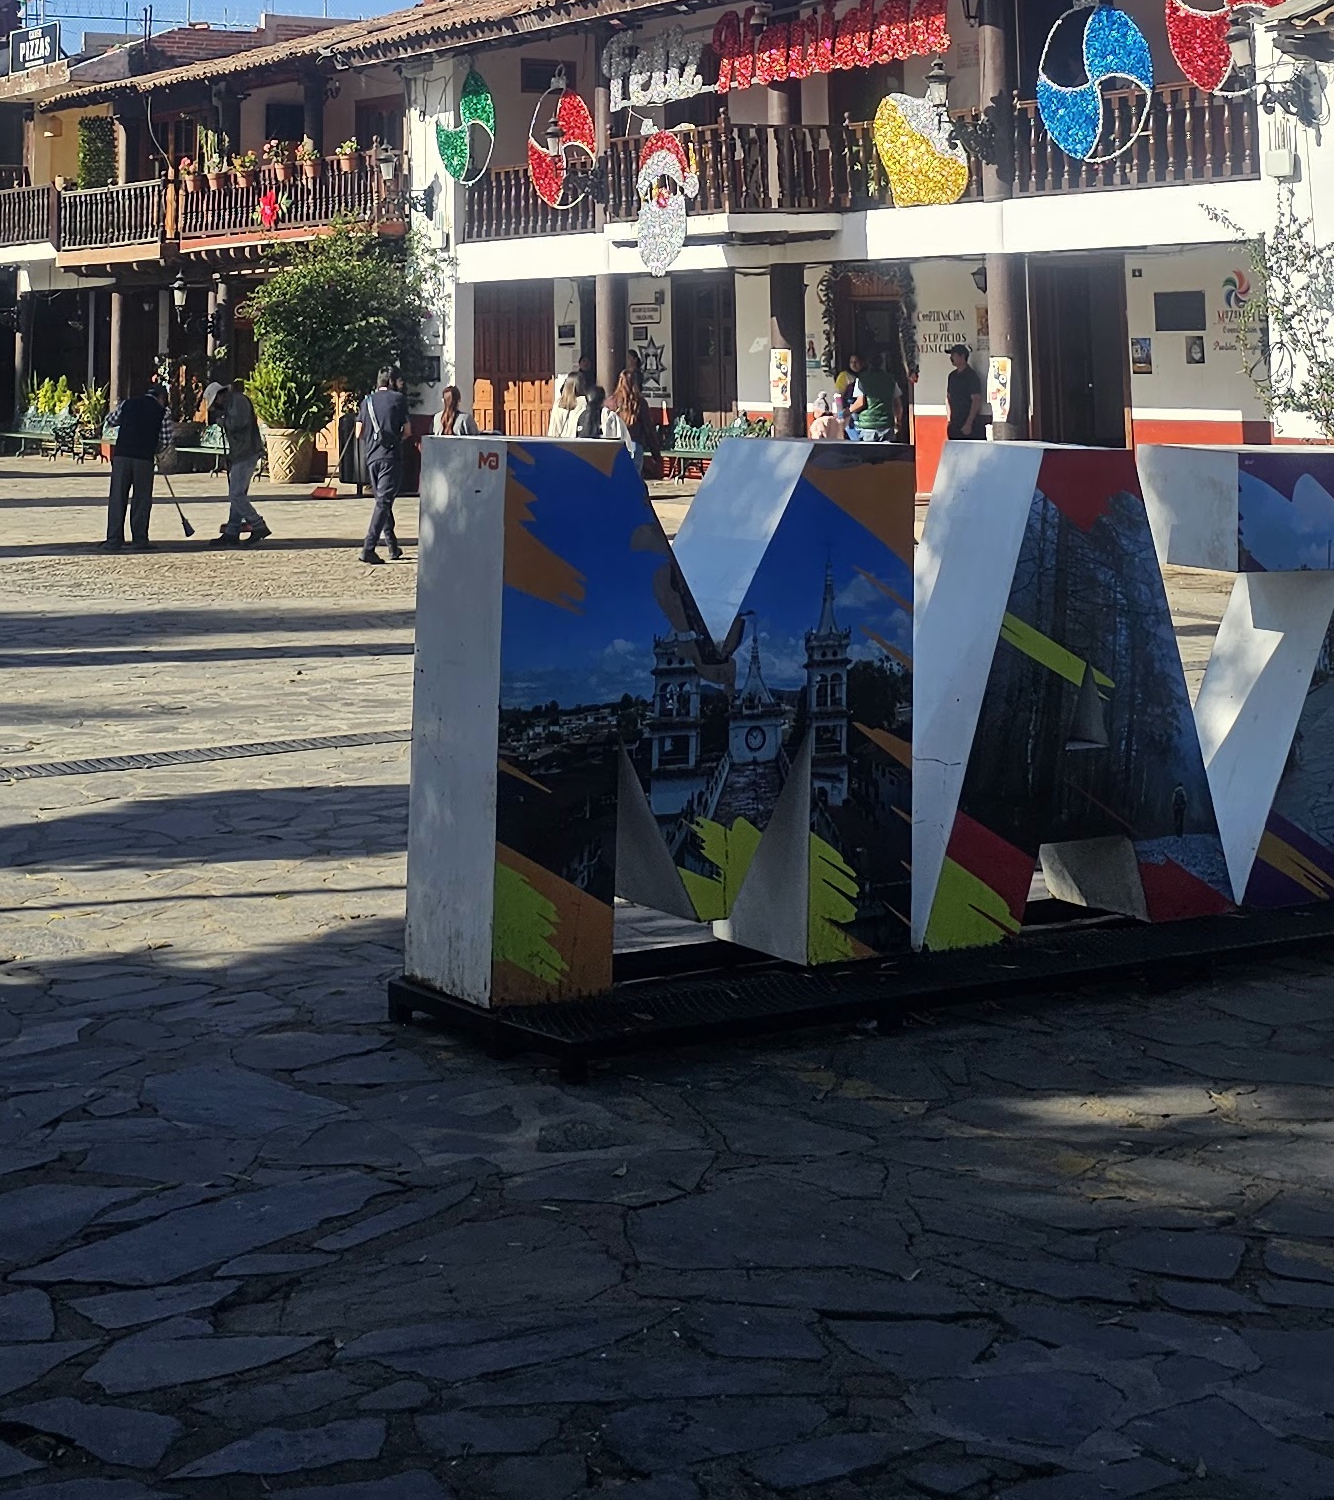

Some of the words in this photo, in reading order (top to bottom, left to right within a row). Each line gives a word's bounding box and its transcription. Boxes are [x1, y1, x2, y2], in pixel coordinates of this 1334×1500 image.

[19, 36, 51, 62] PIZZAS
[938, 322, 950, 333] DE
[917, 343, 973, 354] MUNICIPS
